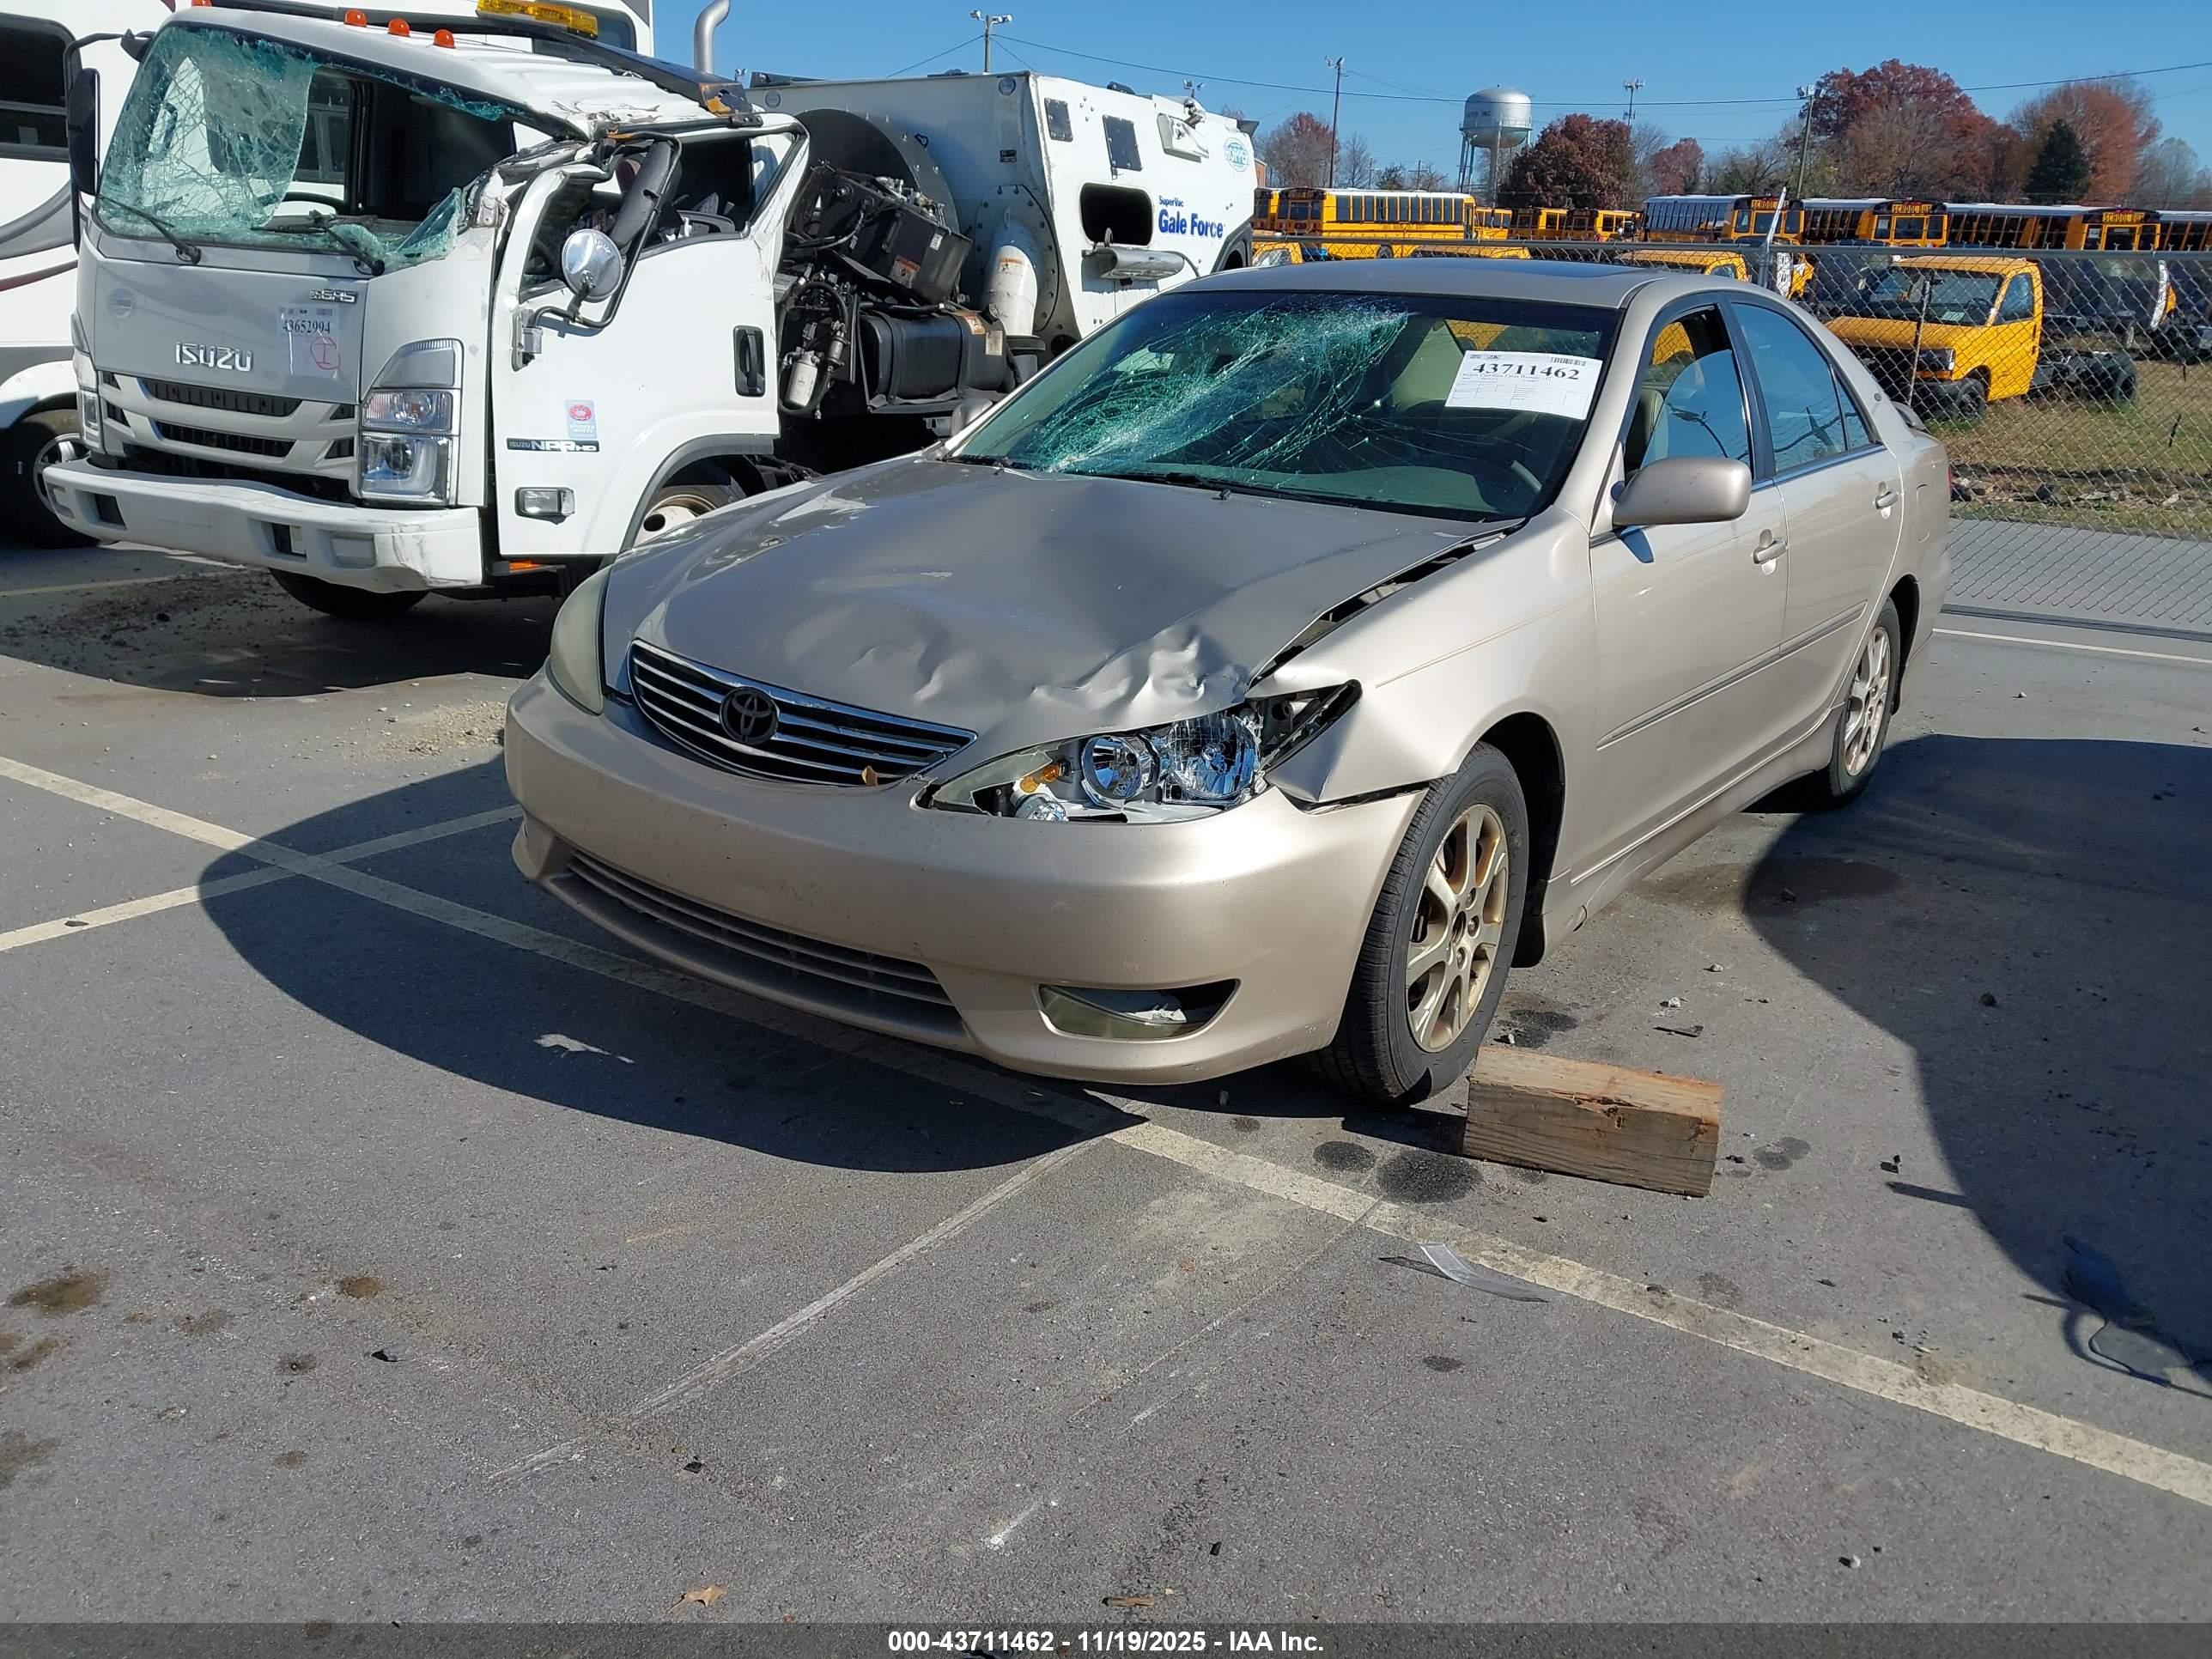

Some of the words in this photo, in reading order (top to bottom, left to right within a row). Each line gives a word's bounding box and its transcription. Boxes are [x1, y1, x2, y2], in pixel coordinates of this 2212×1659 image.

[1158, 209, 1187, 234] Gale
[1190, 212, 1224, 239] Force
[283, 319, 331, 334] 43652994
[175, 343, 252, 372] ISUZU
[1473, 362, 1580, 380] 43711462
